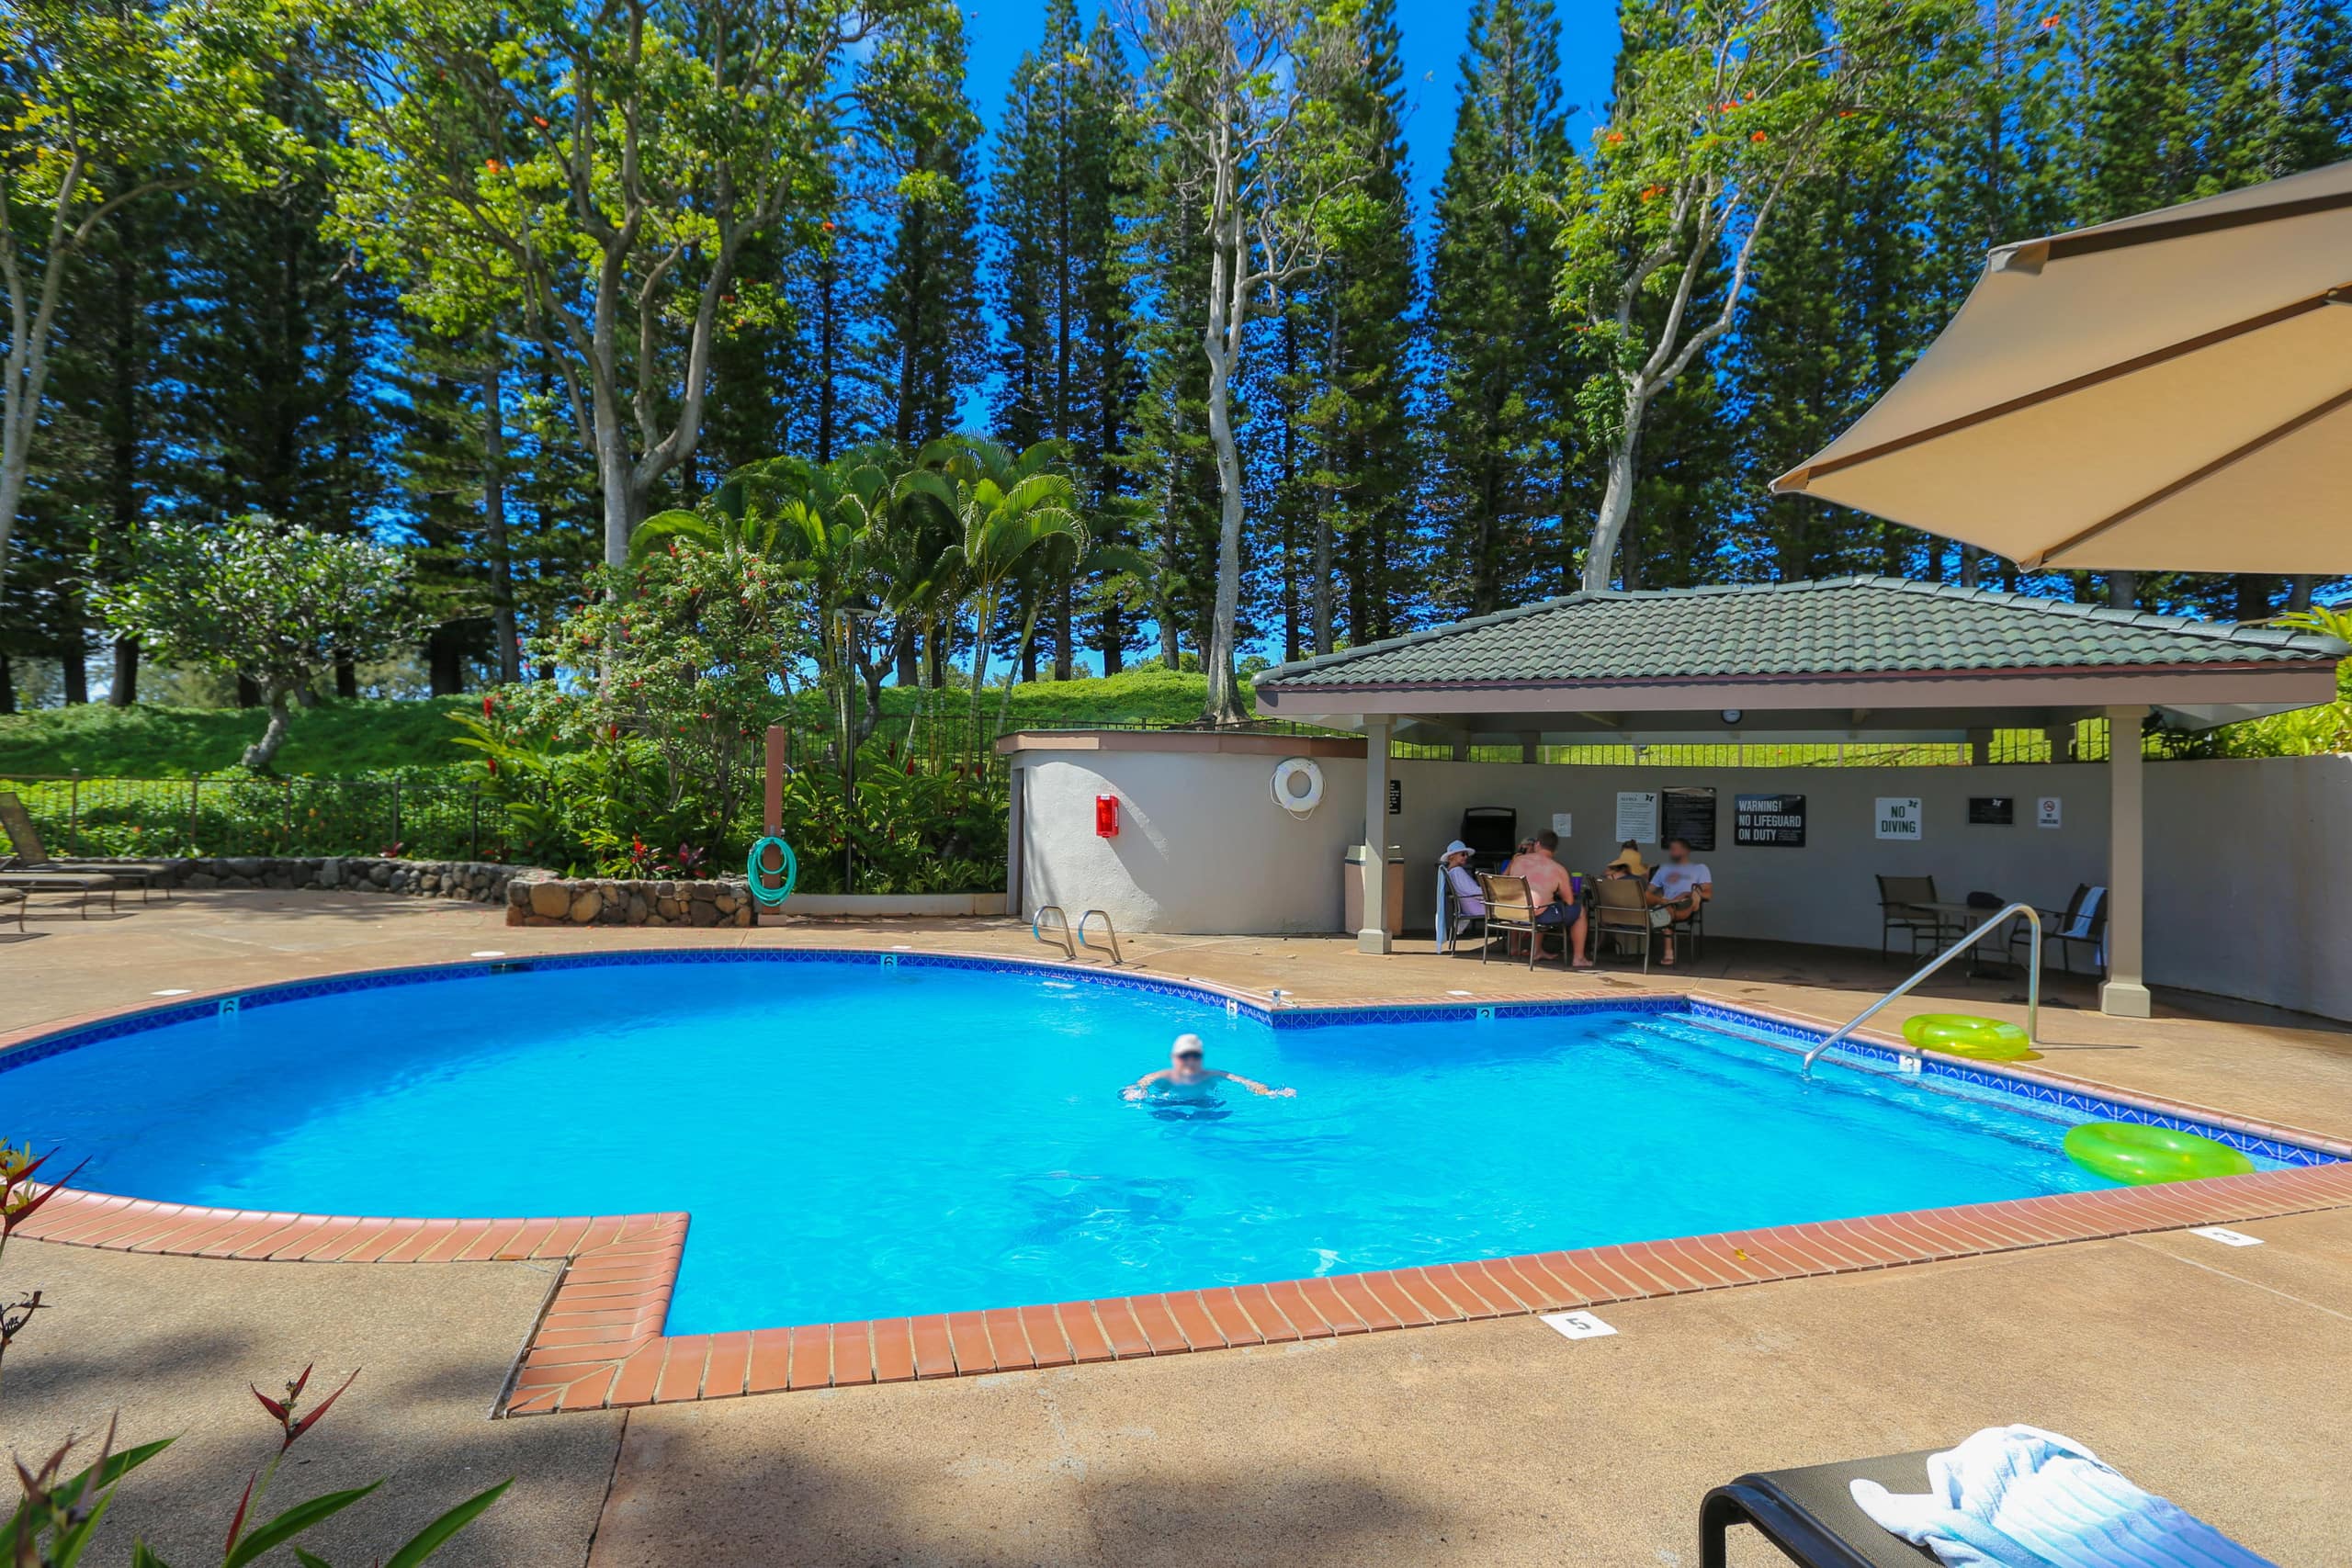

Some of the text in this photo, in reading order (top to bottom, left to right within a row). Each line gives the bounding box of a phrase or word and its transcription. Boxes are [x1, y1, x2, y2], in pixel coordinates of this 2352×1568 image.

[1738, 800, 1782, 812] WARNING!
[1891, 806, 1905, 818] NO
[1738, 815, 1802, 828] NO LIFEGUARD
[1882, 820, 1916, 833] DIVING
[1738, 829, 1750, 840] ON
[1753, 829, 1777, 840] DUTY
[884, 956, 894, 965] 6
[1566, 1318, 1591, 1331] 5
